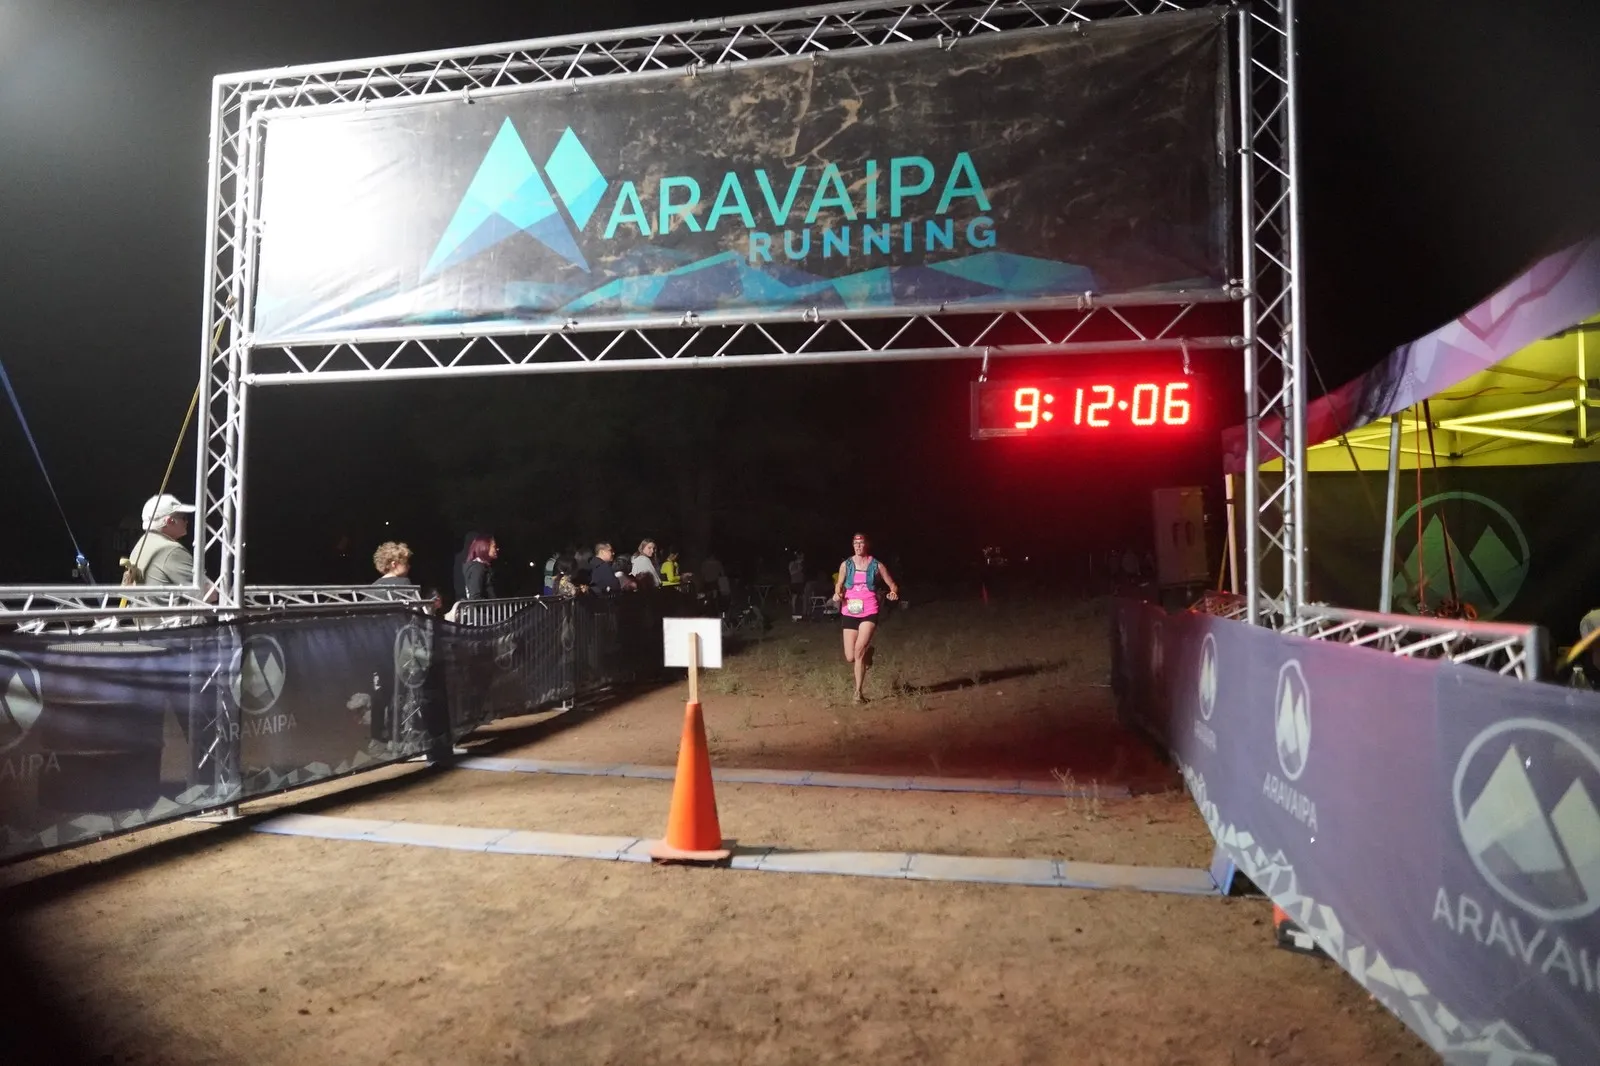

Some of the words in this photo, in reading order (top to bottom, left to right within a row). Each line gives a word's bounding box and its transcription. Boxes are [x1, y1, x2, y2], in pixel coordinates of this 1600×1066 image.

[604, 151, 991, 240] ARAVAIPA
[748, 216, 997, 264] RUNNING
[219, 712, 297, 742] ARAVAIPA
[1263, 771, 1318, 833] ARAVAIPA
[1432, 887, 1600, 993] ARAVAI
